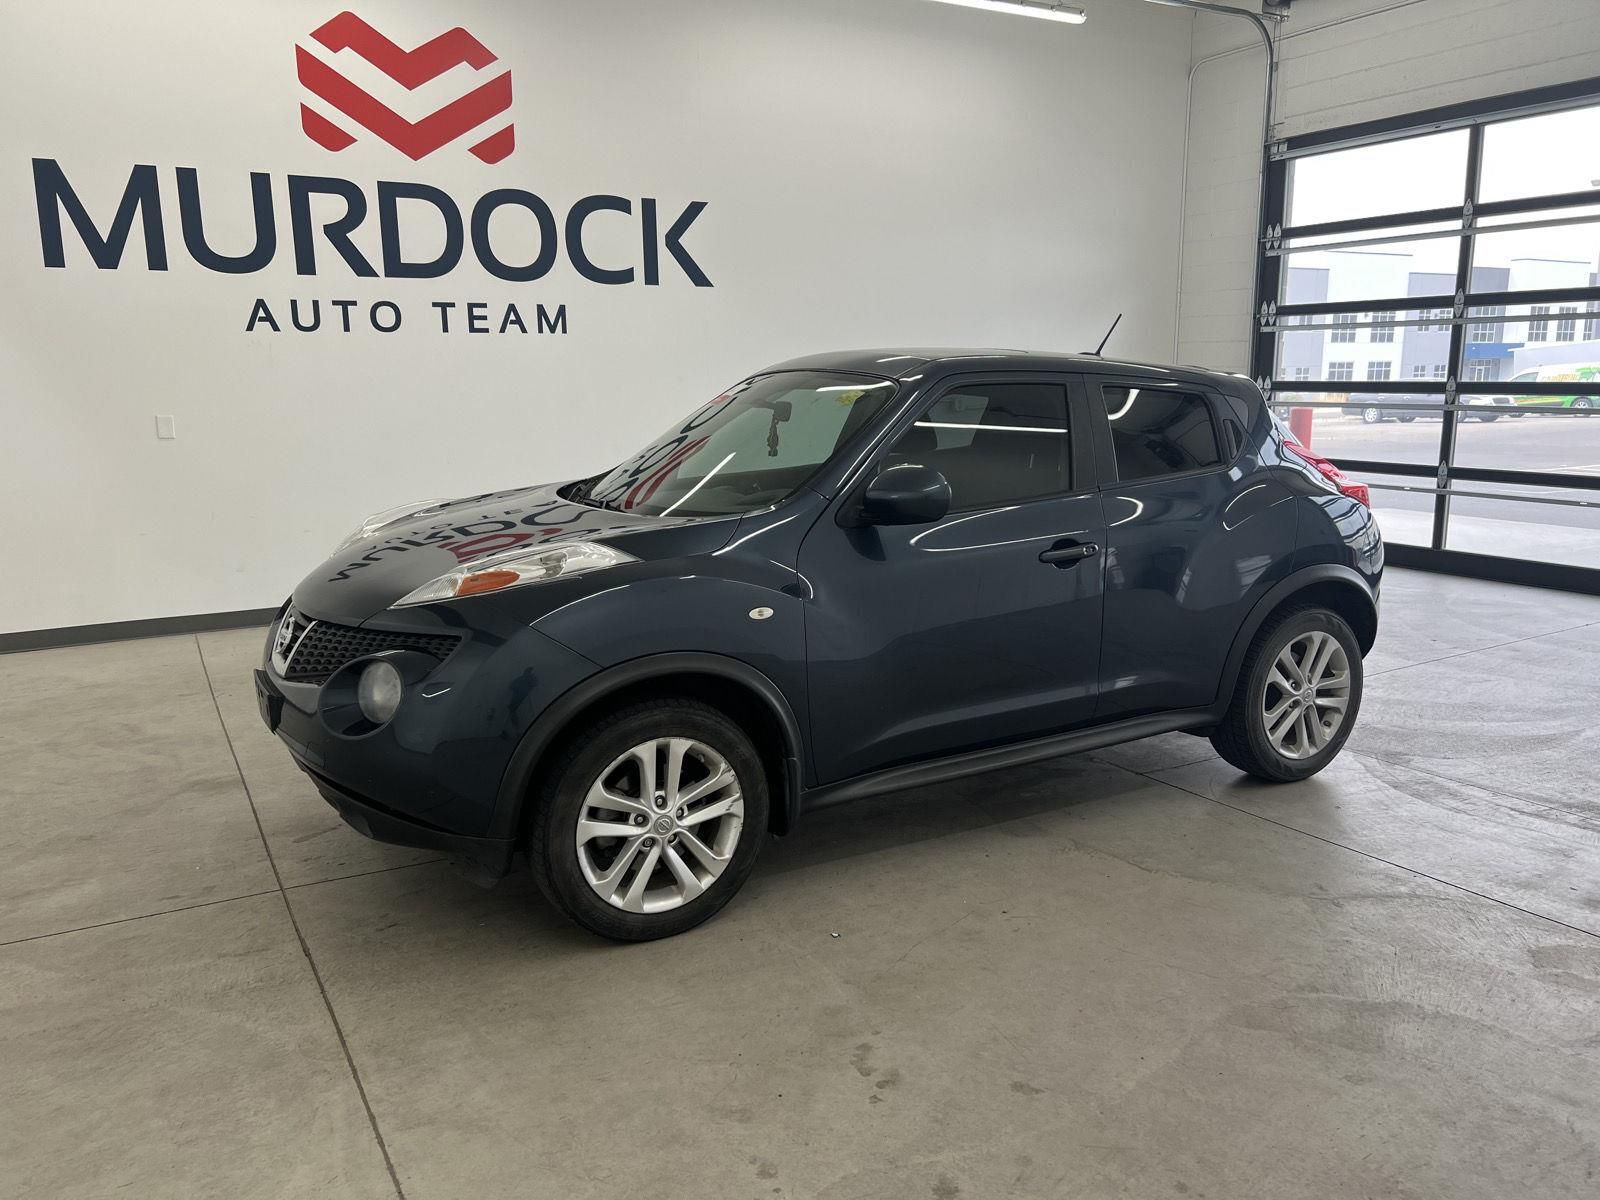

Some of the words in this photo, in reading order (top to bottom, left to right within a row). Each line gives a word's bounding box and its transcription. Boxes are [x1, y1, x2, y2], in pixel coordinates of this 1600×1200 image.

[32, 158, 714, 287] MURDOCK
[246, 298, 402, 333] AUTO
[432, 301, 568, 334] TEAM
